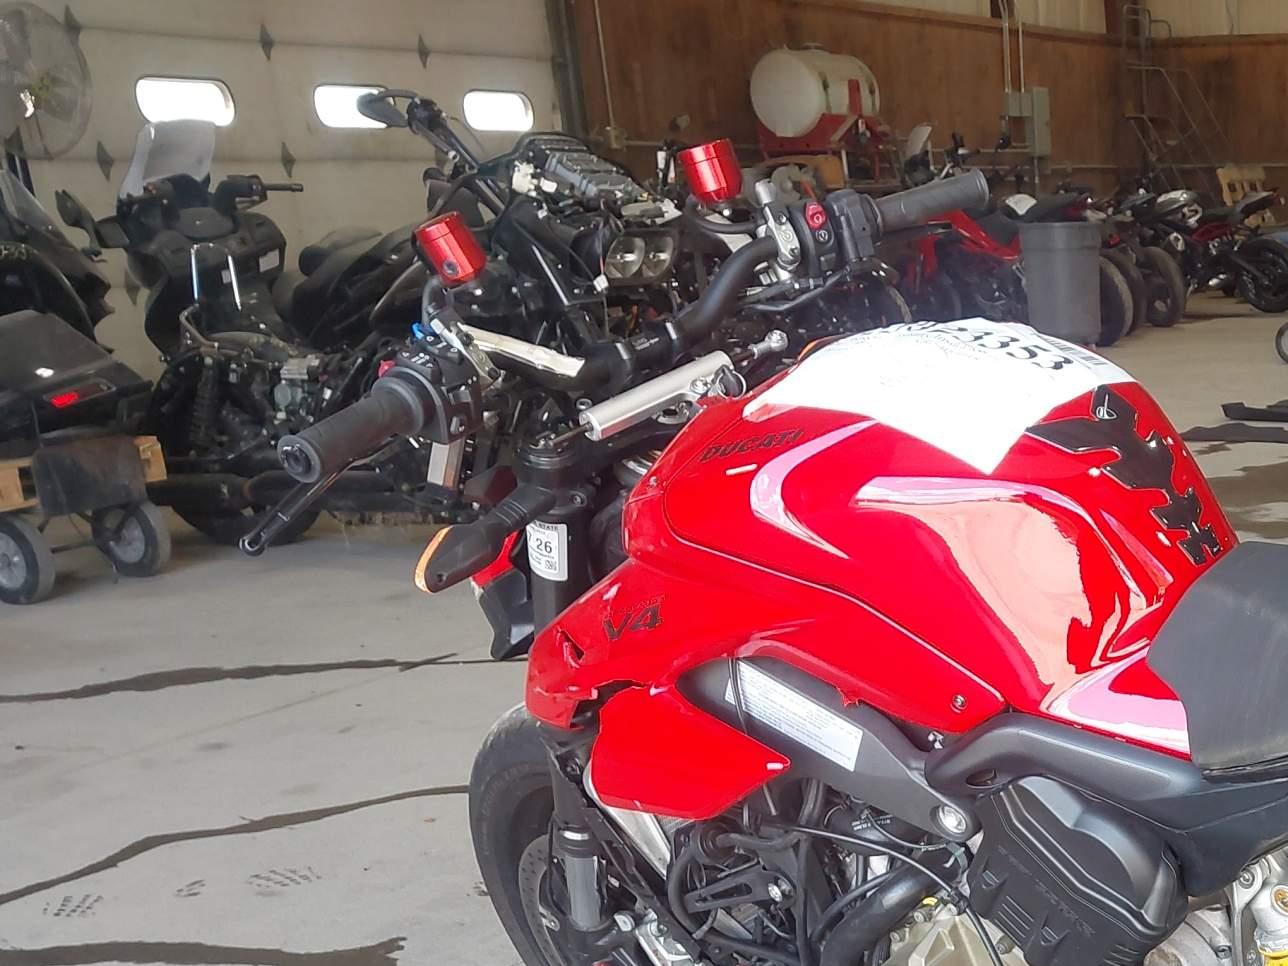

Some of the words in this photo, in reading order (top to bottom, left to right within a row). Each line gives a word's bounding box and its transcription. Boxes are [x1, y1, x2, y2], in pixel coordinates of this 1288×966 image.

[699, 428, 804, 462] DUCATI
[536, 537, 553, 554] 26
[603, 603, 664, 640] V4
